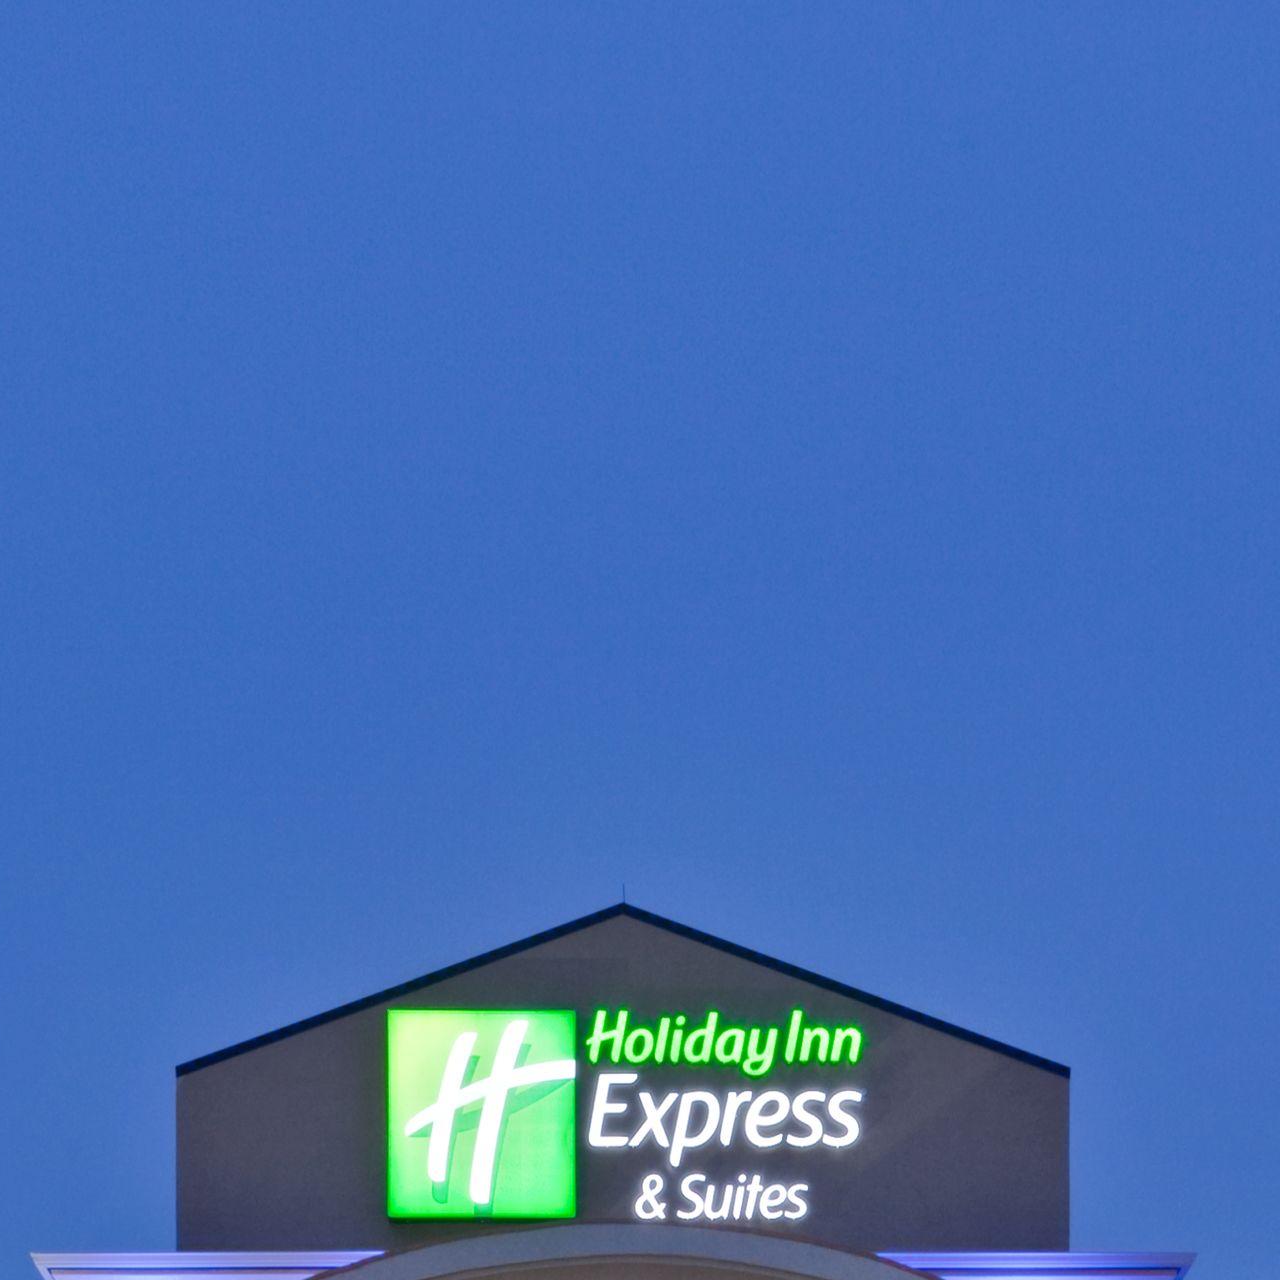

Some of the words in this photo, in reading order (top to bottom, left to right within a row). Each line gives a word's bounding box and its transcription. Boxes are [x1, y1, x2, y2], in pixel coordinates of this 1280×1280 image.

[585, 1009, 779, 1077] Holiday
[784, 1009, 863, 1065] Inn
[404, 1019, 576, 1205] H
[587, 1072, 864, 1169] Express
[634, 1173, 667, 1221] &
[676, 1173, 810, 1221] Suites
